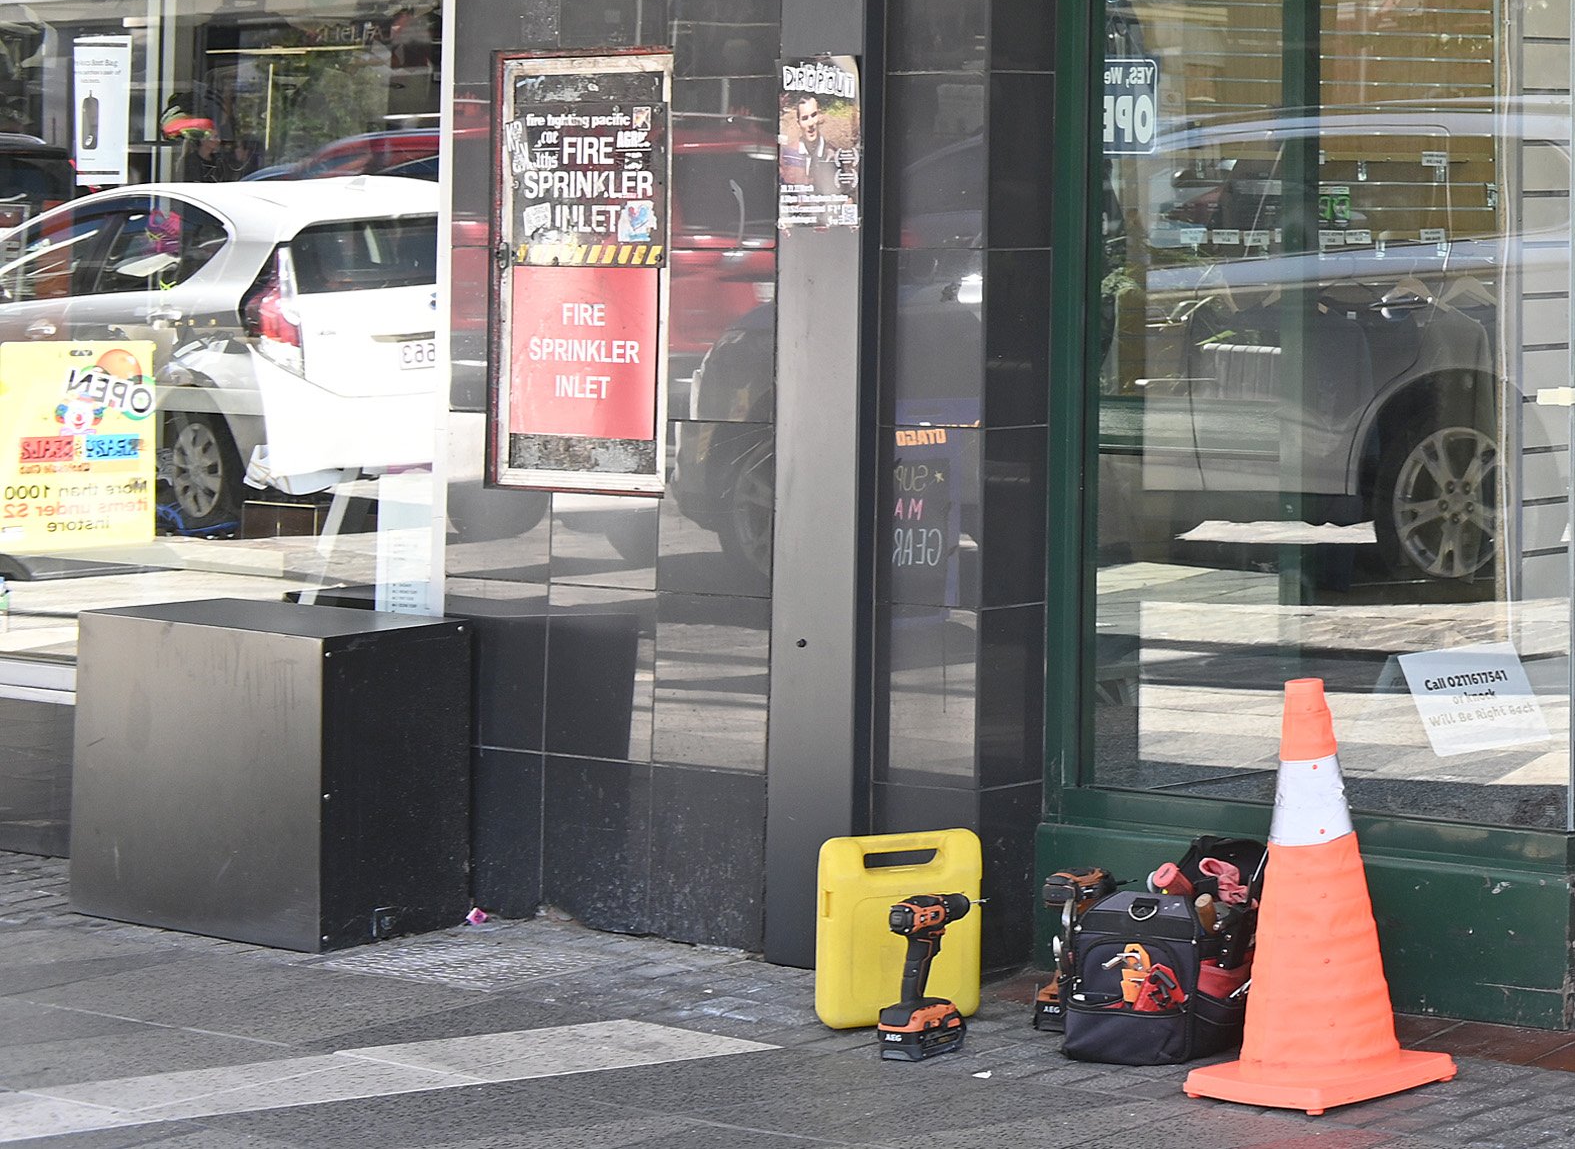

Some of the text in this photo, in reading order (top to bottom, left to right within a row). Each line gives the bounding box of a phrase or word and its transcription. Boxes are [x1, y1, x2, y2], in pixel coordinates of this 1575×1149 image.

[526, 113, 546, 127] fire
[591, 112, 631, 129] pacific
[562, 136, 614, 165] FIRE
[523, 171, 653, 199] SPRINKLER
[555, 204, 621, 233] INLET
[562, 302, 606, 327] FIRE
[529, 336, 640, 364] SPRINKLER
[555, 375, 611, 399] INLET
[1424, 669, 1508, 692] Call 0211617541
[1453, 688, 1498, 705] or knock
[1429, 702, 1536, 728] Will Be Right Back
[1043, 1005, 1060, 1014] AEG
[885, 1033, 902, 1042] AEG
